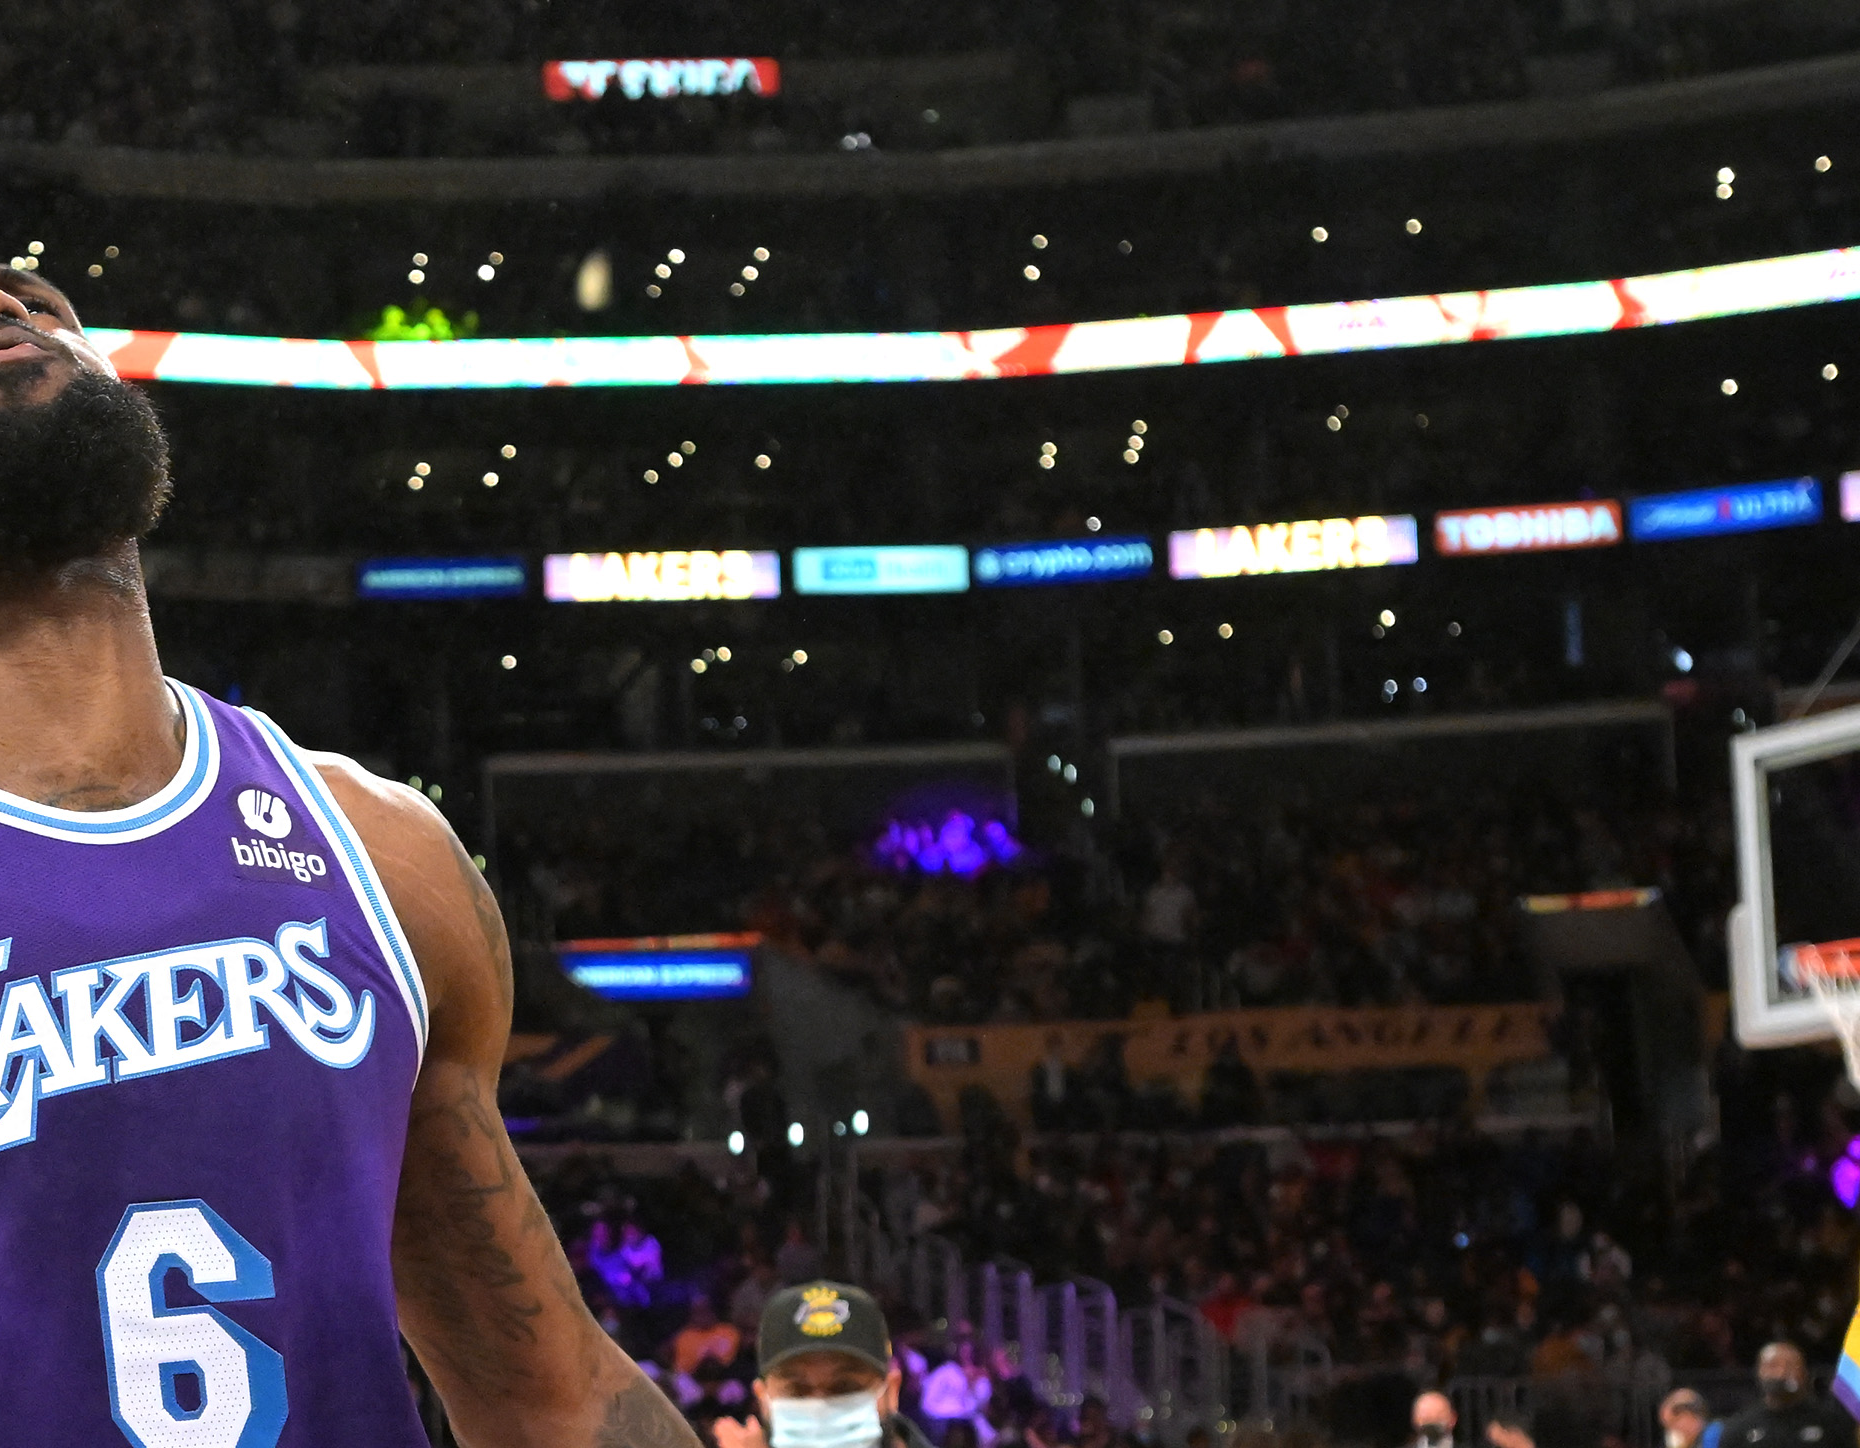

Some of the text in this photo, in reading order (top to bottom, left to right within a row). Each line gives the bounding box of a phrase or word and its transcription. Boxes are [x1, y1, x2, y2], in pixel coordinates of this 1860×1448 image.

[1196, 515, 1390, 579] LAKERS
[1440, 505, 1617, 550] TOSHIBA
[569, 550, 752, 602] LAKERS
[231, 837, 327, 883] bibigo
